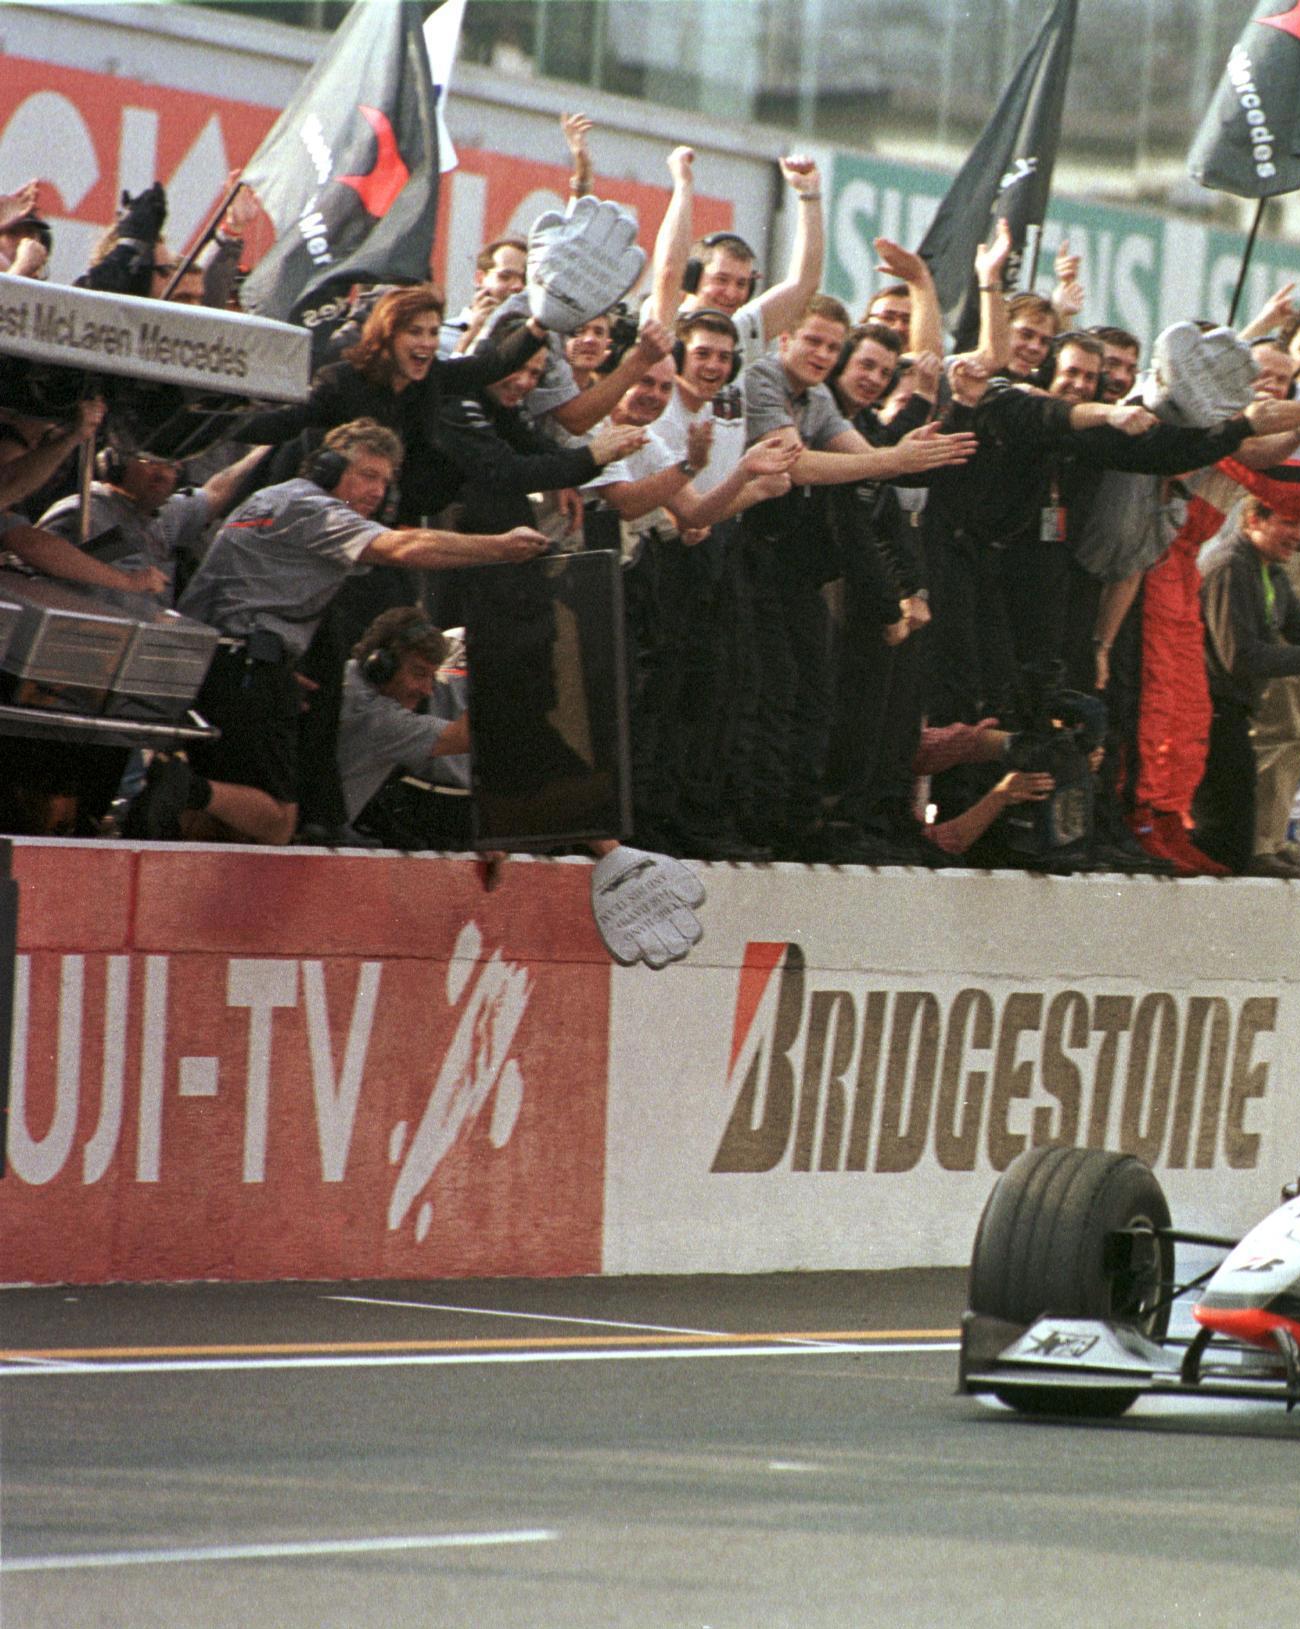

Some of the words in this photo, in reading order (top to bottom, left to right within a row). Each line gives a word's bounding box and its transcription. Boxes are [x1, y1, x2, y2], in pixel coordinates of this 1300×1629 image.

[0, 302, 28, 338] est
[31, 302, 132, 358] McLaren
[137, 323, 250, 378] Mercedes
[6, 954, 383, 1186] UJI-TV
[708, 941, 1278, 1174] BRIDGESTONE
